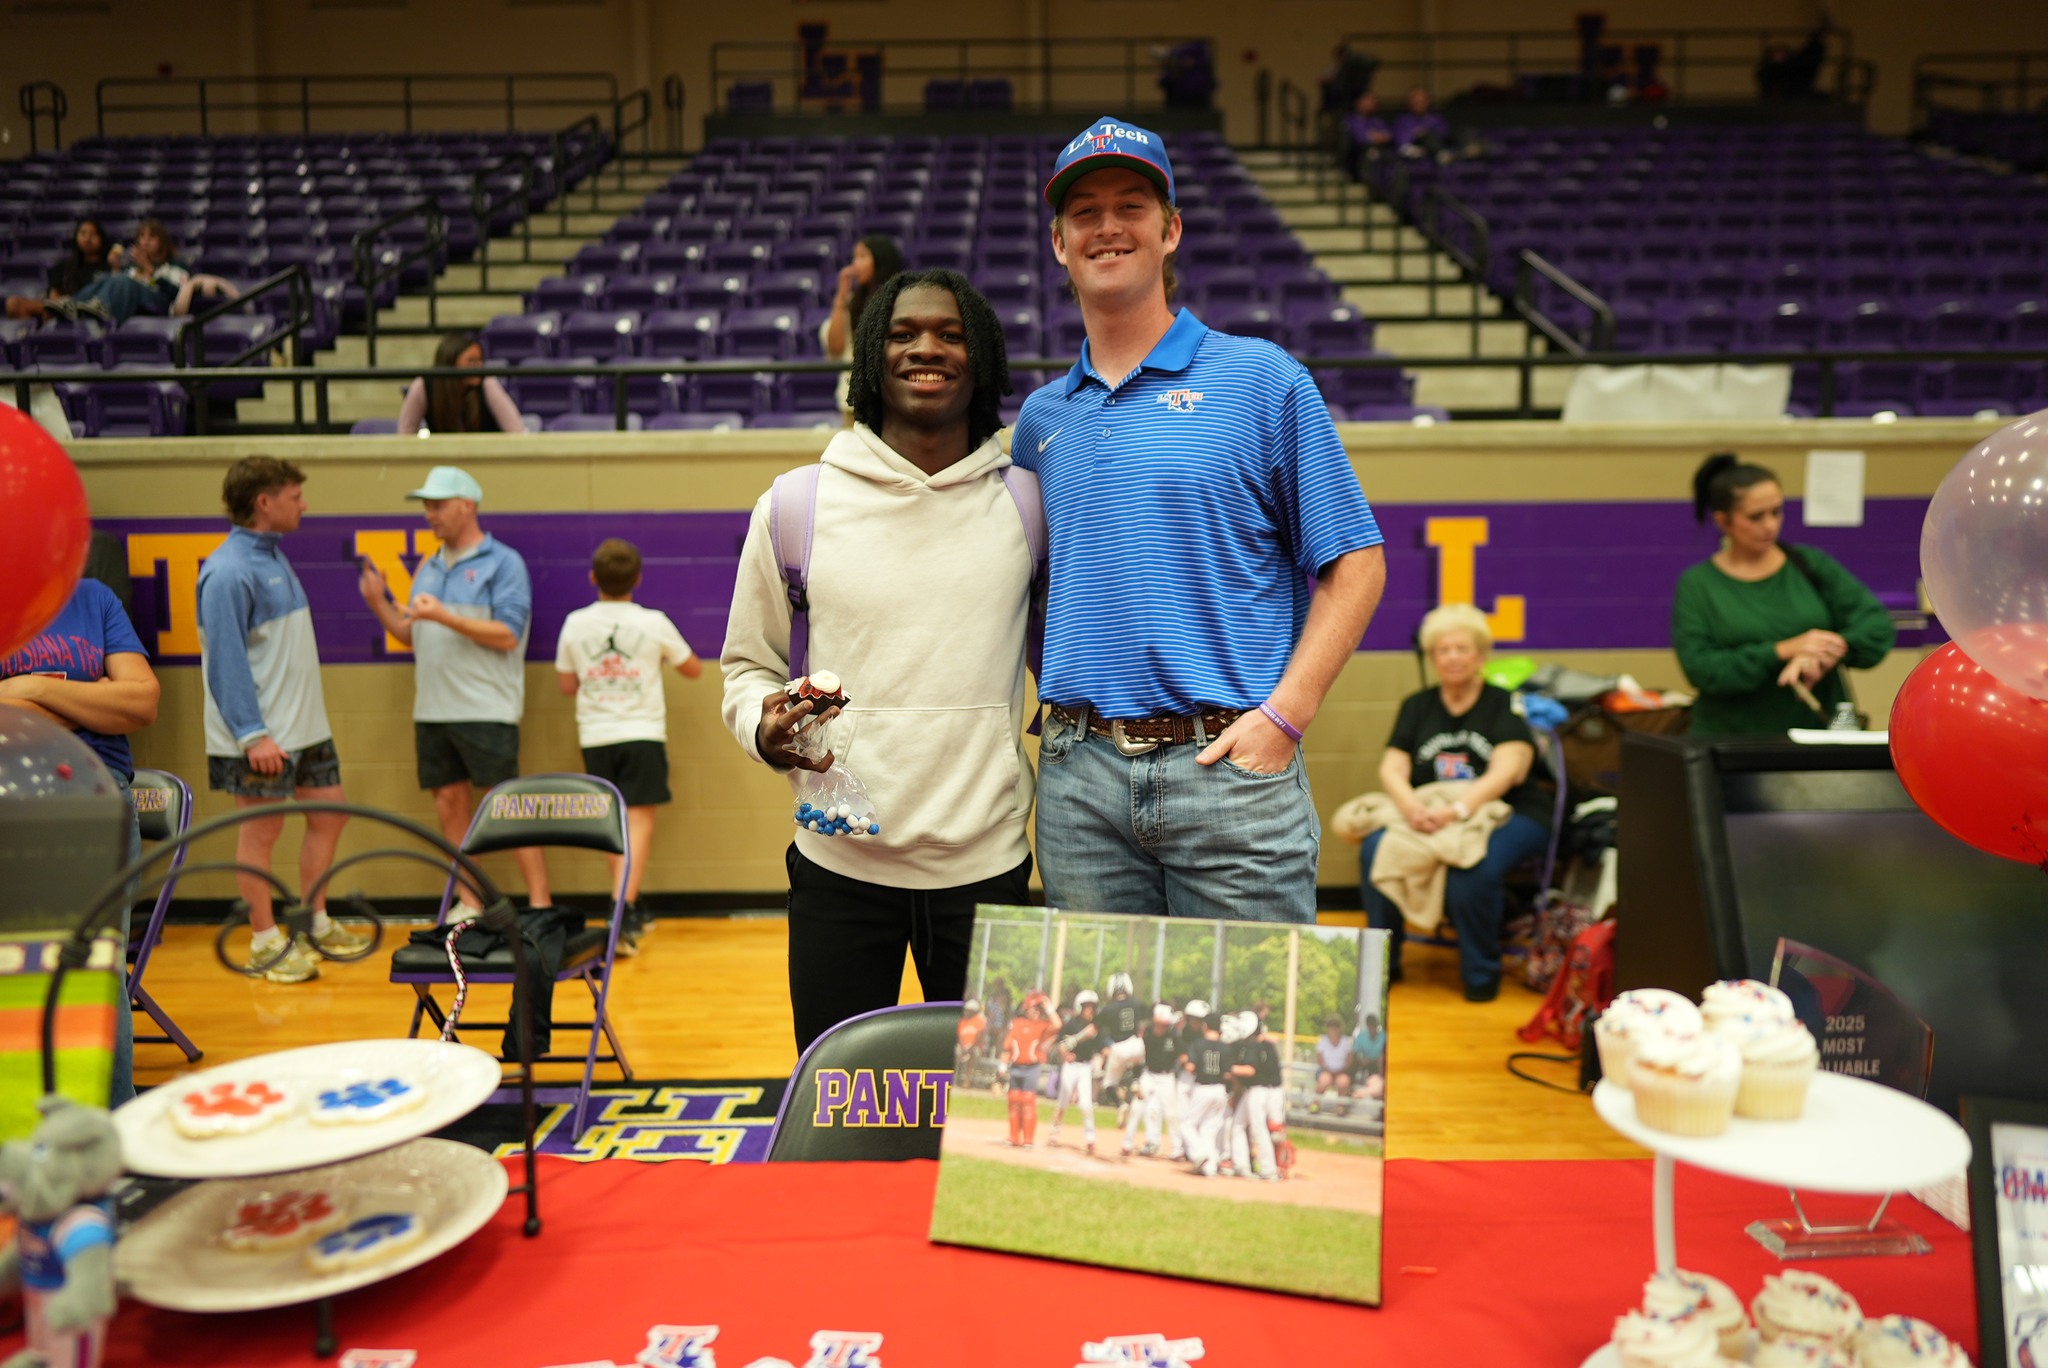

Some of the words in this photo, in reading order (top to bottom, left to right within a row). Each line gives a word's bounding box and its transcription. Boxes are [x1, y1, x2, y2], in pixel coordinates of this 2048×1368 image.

[1066, 130, 1095, 156] LA
[1099, 123, 1149, 145] Tech
[131, 788, 172, 812] ERS
[491, 793, 612, 819] PANTHERS
[1119, 1008, 1135, 1032] 2
[1825, 1014, 1866, 1032] 2025
[1823, 1037, 1866, 1054] MOST
[1203, 1049, 1221, 1075] 11
[1816, 1059, 1880, 1076] ALUABLE
